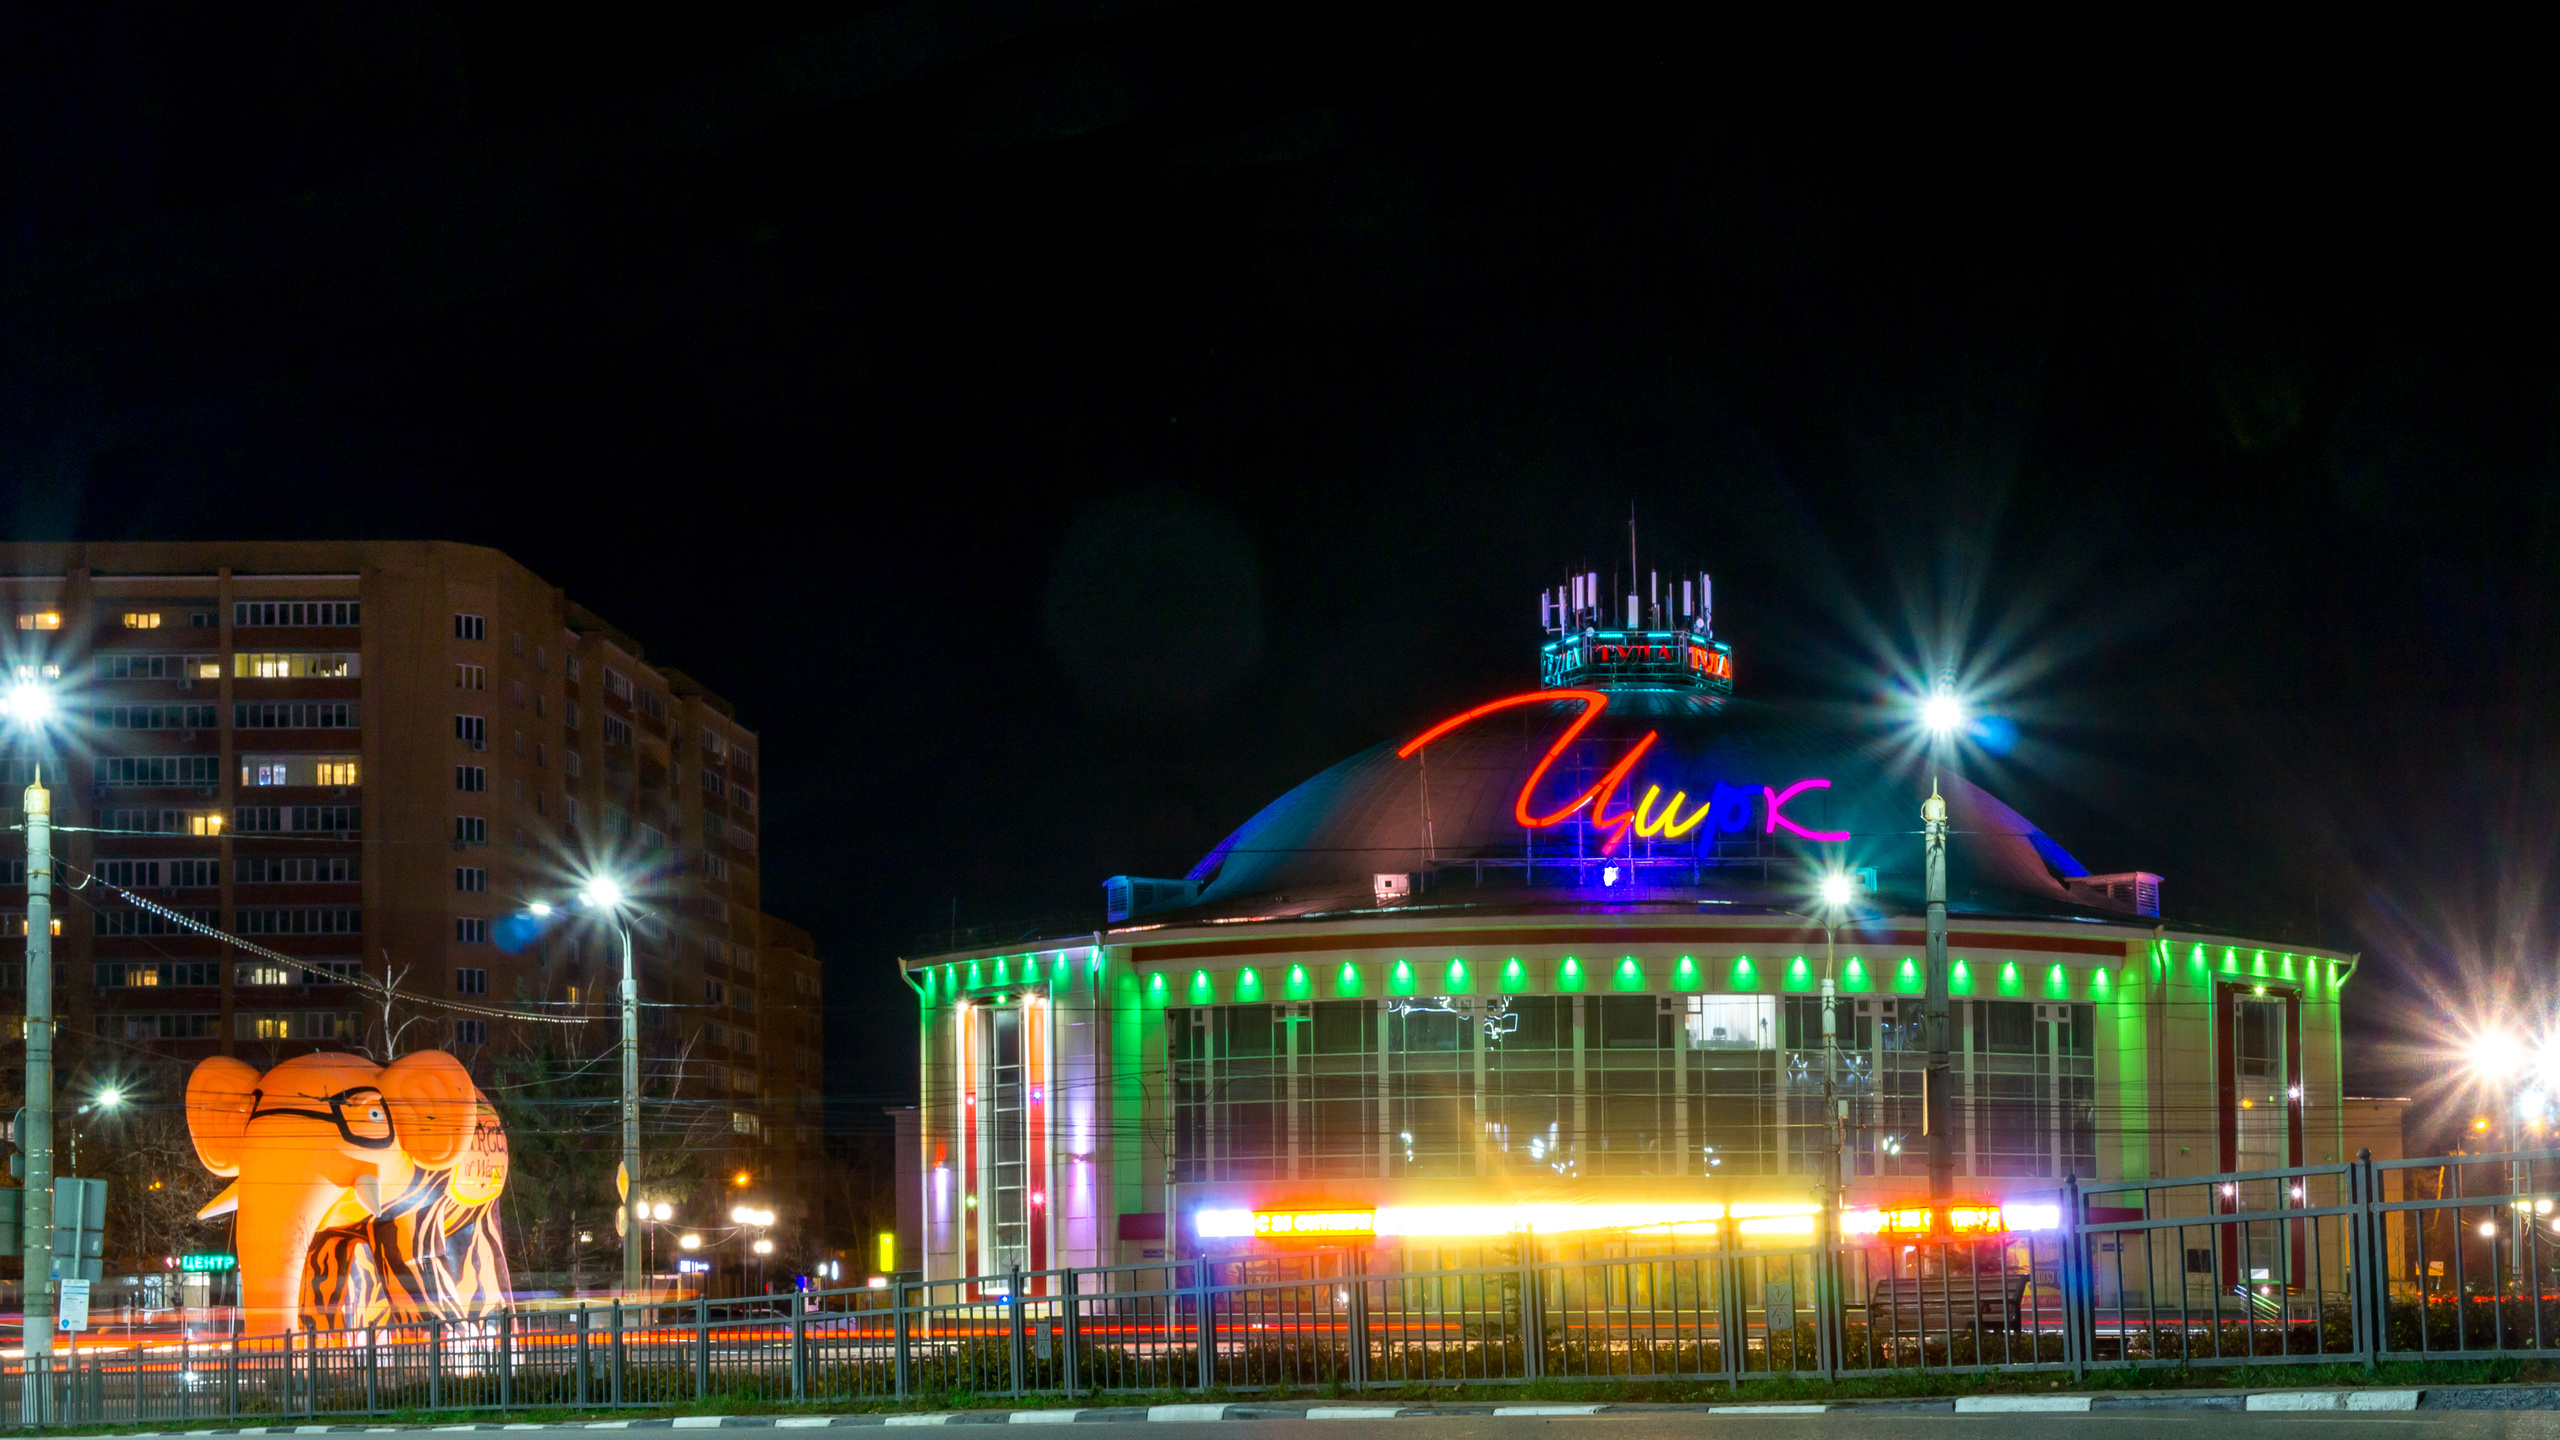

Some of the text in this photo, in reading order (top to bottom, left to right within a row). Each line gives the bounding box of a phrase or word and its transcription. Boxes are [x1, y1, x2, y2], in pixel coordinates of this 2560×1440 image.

[1595, 644, 1672, 665] ТУЛА
[1689, 646, 1731, 679] ТУЛА
[1398, 690, 1851, 858] Цирк
[182, 1255, 236, 1271] ЦЕНТР
